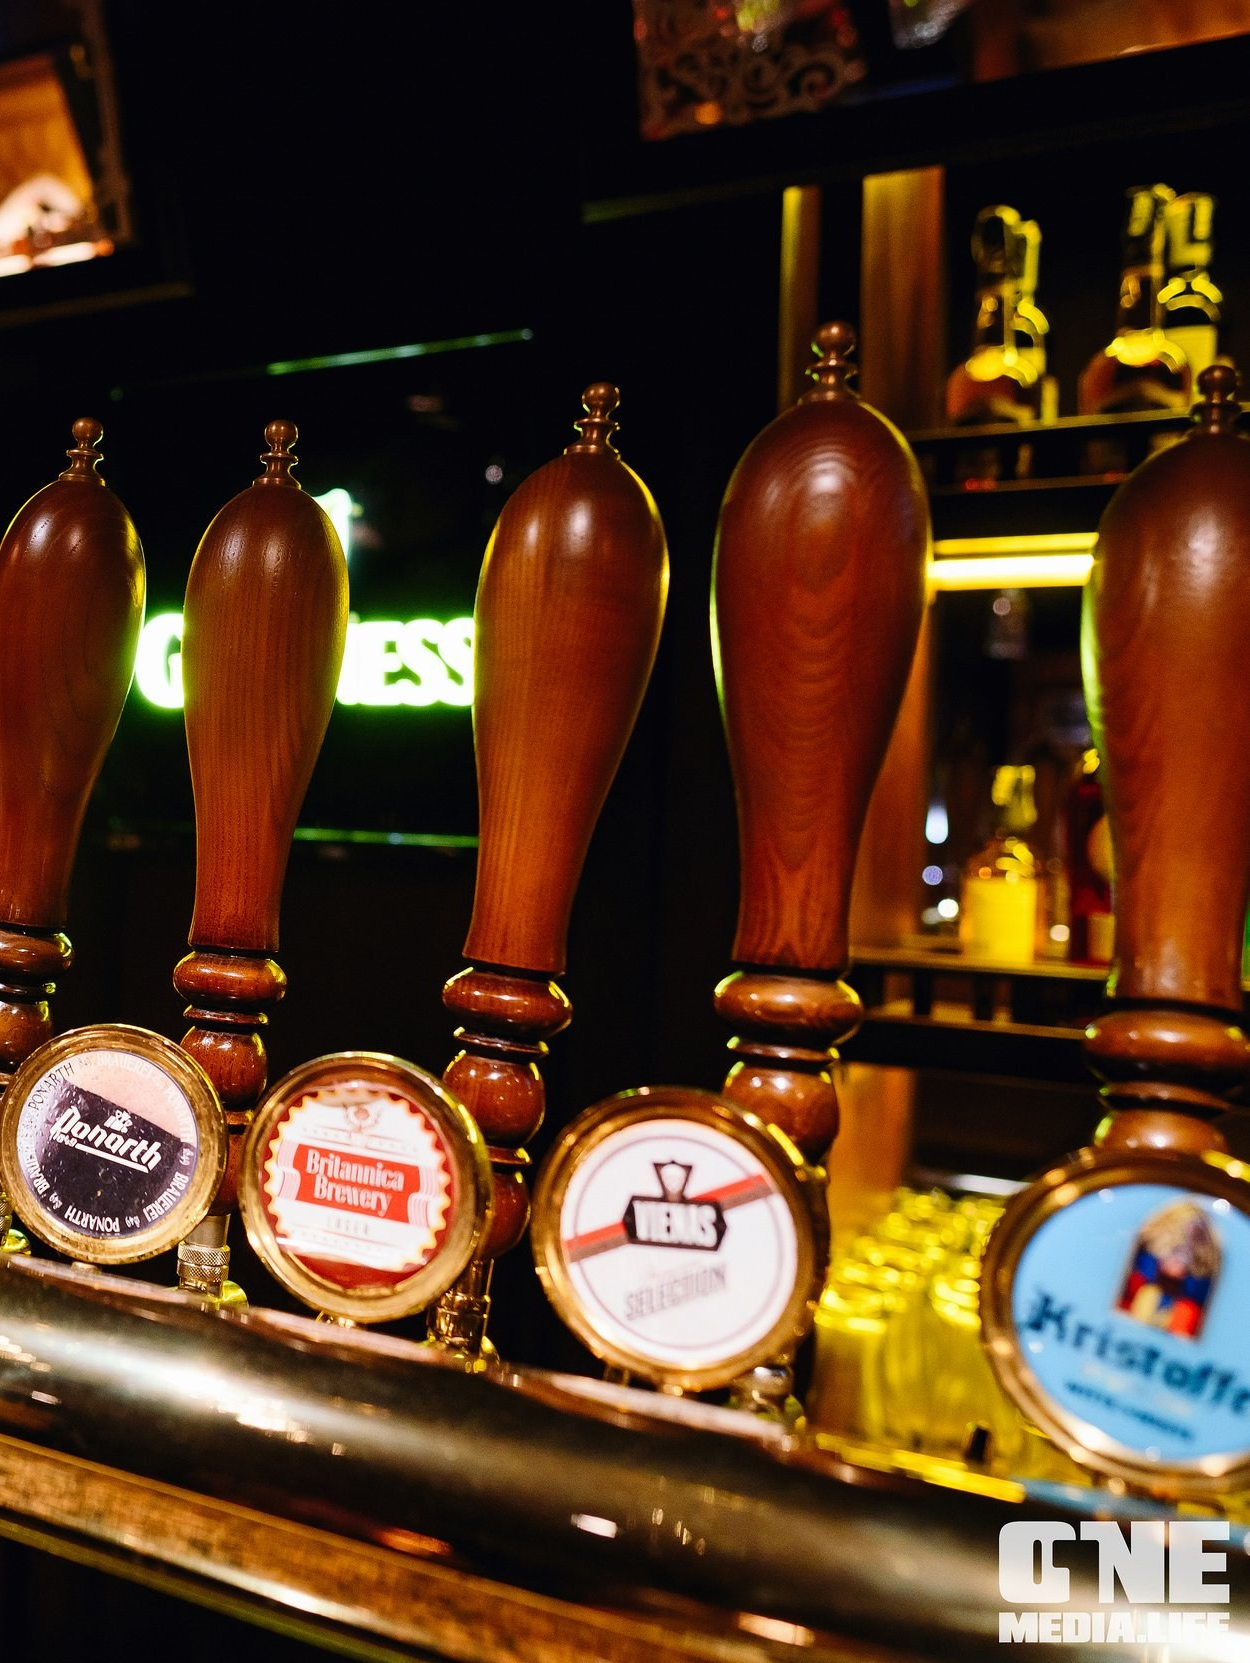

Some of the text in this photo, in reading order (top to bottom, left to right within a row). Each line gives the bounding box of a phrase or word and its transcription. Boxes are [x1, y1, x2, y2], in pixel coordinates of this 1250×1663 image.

[135, 612, 475, 708] GESS
[28, 1062, 74, 1110] PONARTH
[49, 1105, 162, 1171] Ponarth
[306, 1149, 404, 1192] Britannica
[64, 1205, 120, 1233] PONARTH
[143, 1171, 190, 1223] BRAUEREI
[314, 1175, 392, 1217] Brewery
[625, 1264, 726, 1321] SELECTION
